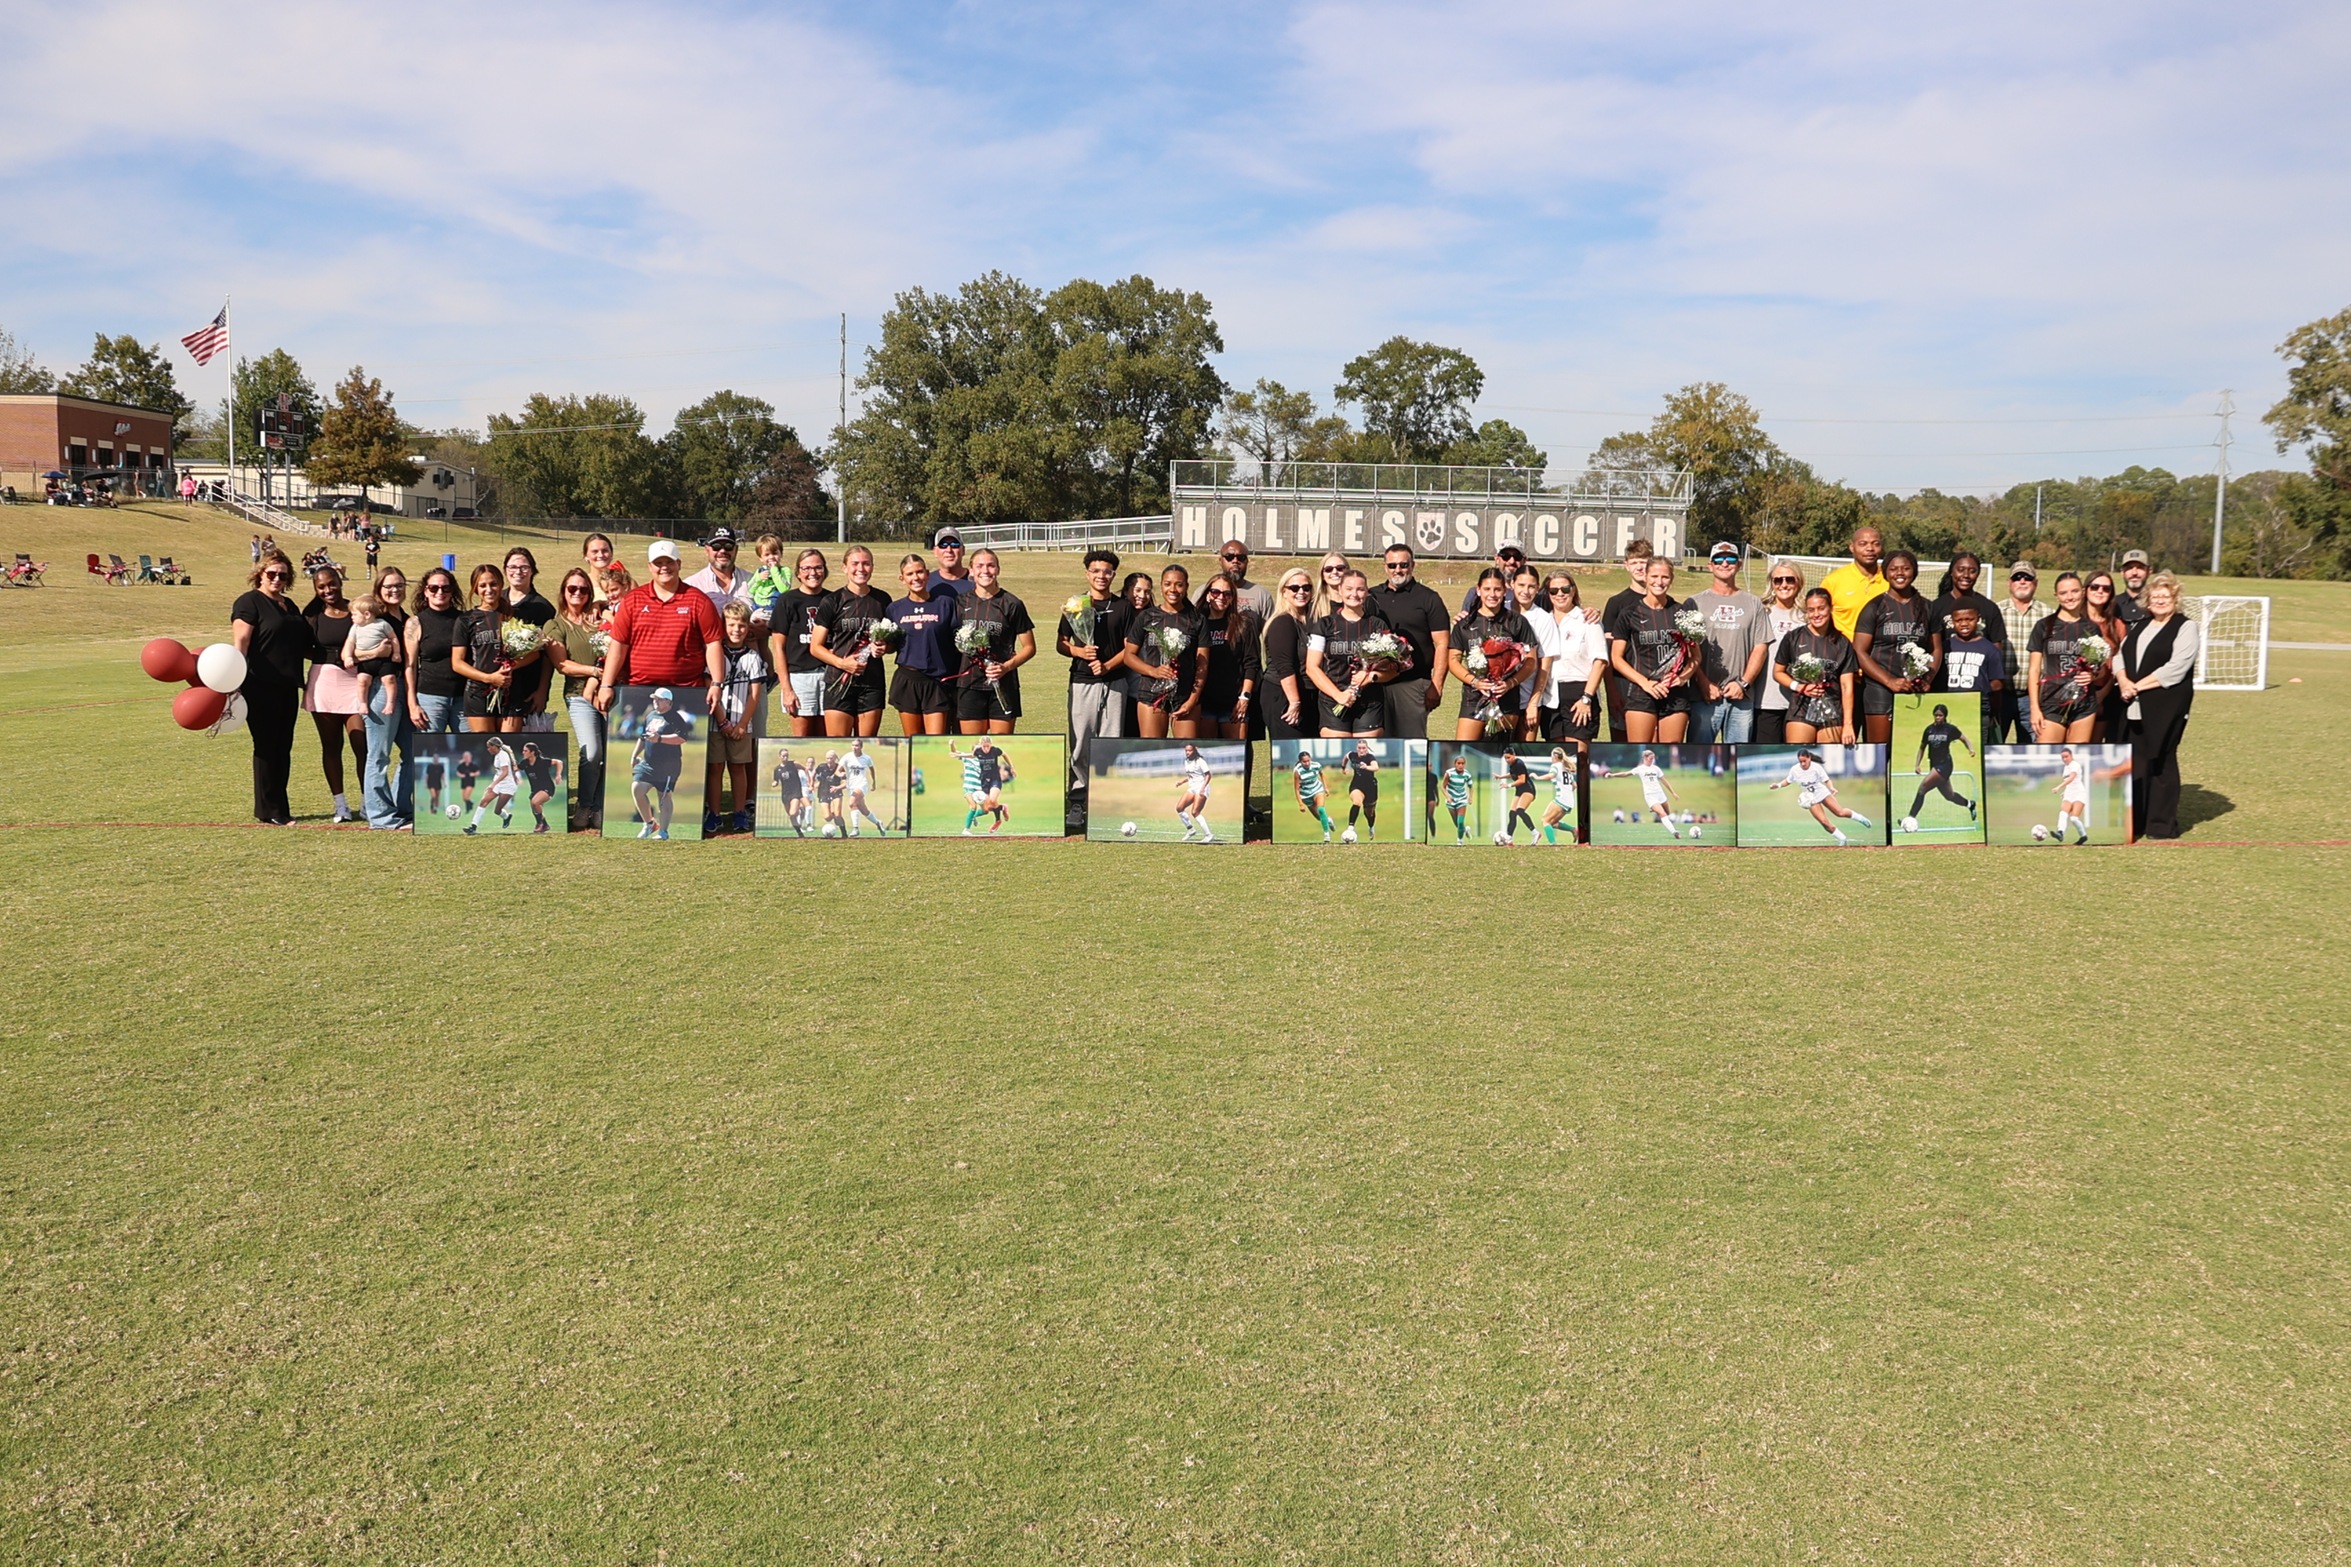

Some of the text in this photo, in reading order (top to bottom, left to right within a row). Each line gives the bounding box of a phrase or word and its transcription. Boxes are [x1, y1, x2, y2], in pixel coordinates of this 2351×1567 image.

[1181, 506, 1677, 558] HOLMES SOCCER
[900, 614, 939, 624] AUBURN
